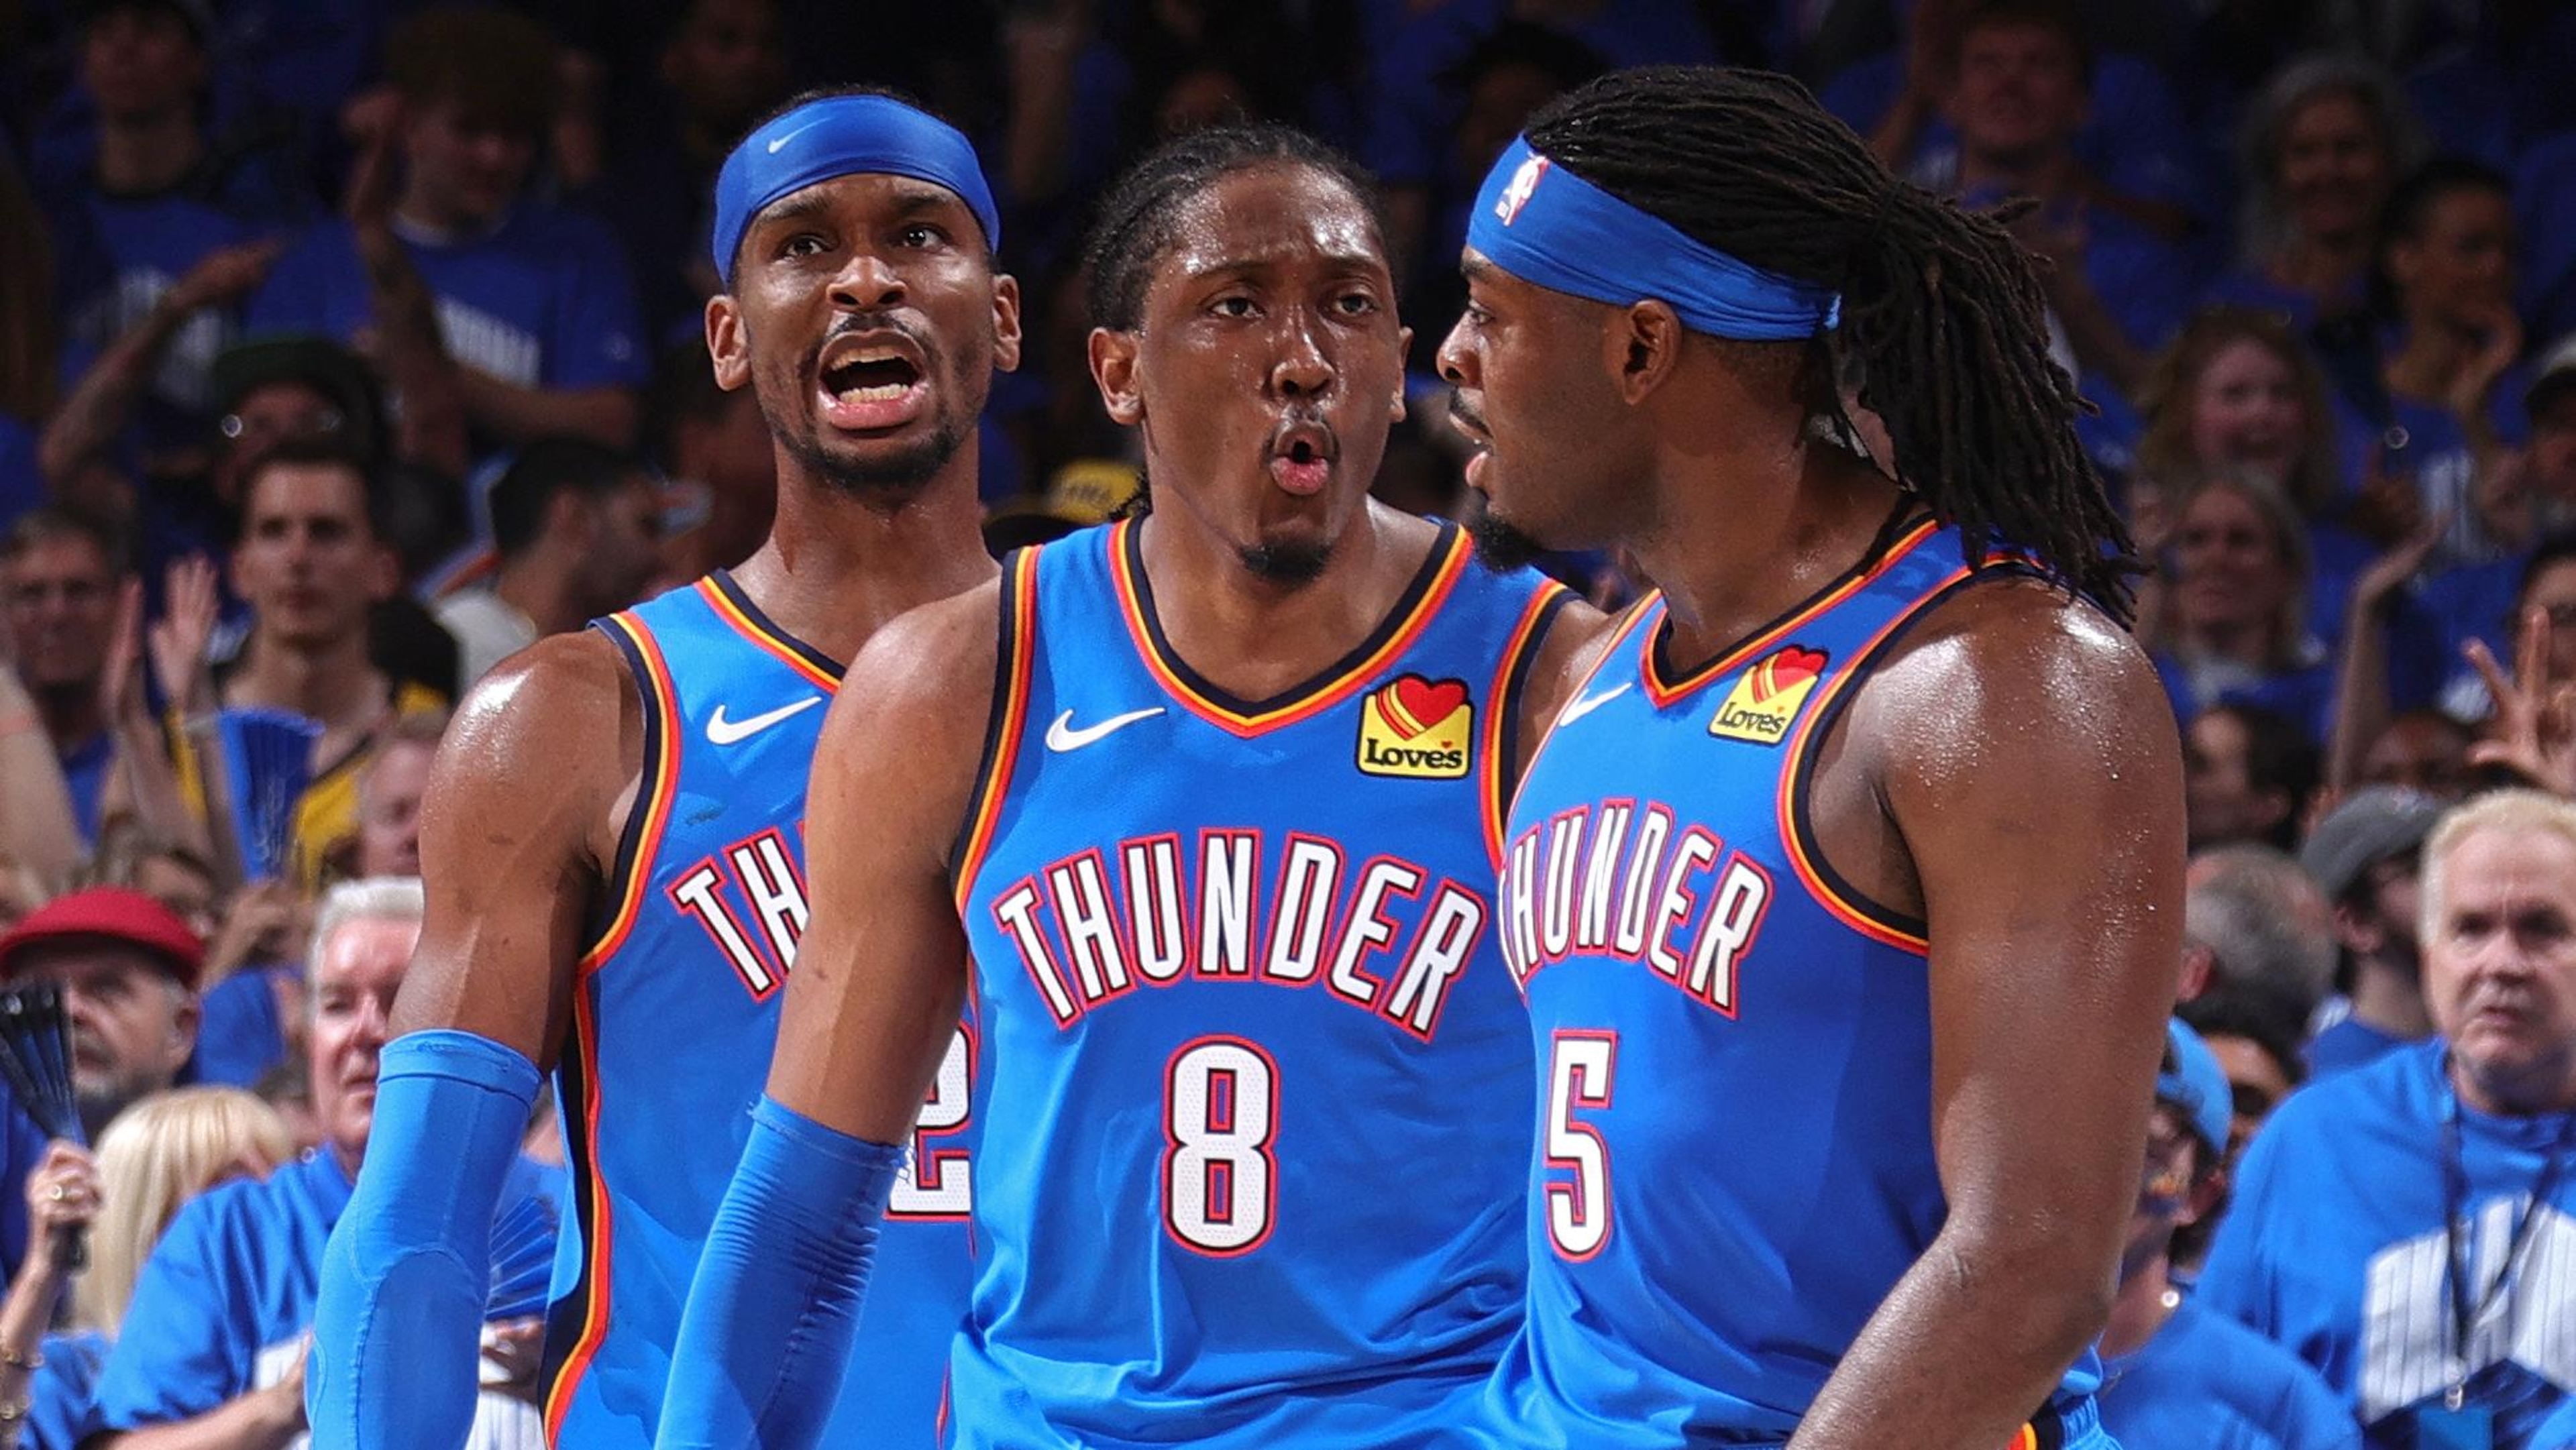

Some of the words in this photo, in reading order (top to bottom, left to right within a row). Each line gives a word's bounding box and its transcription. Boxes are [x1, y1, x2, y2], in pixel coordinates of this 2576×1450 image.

[664, 825, 809, 1004] TH
[990, 827, 1488, 1042] THUNDER
[1161, 1034, 1281, 1258] 8
[1543, 1029, 1617, 1263] 5
